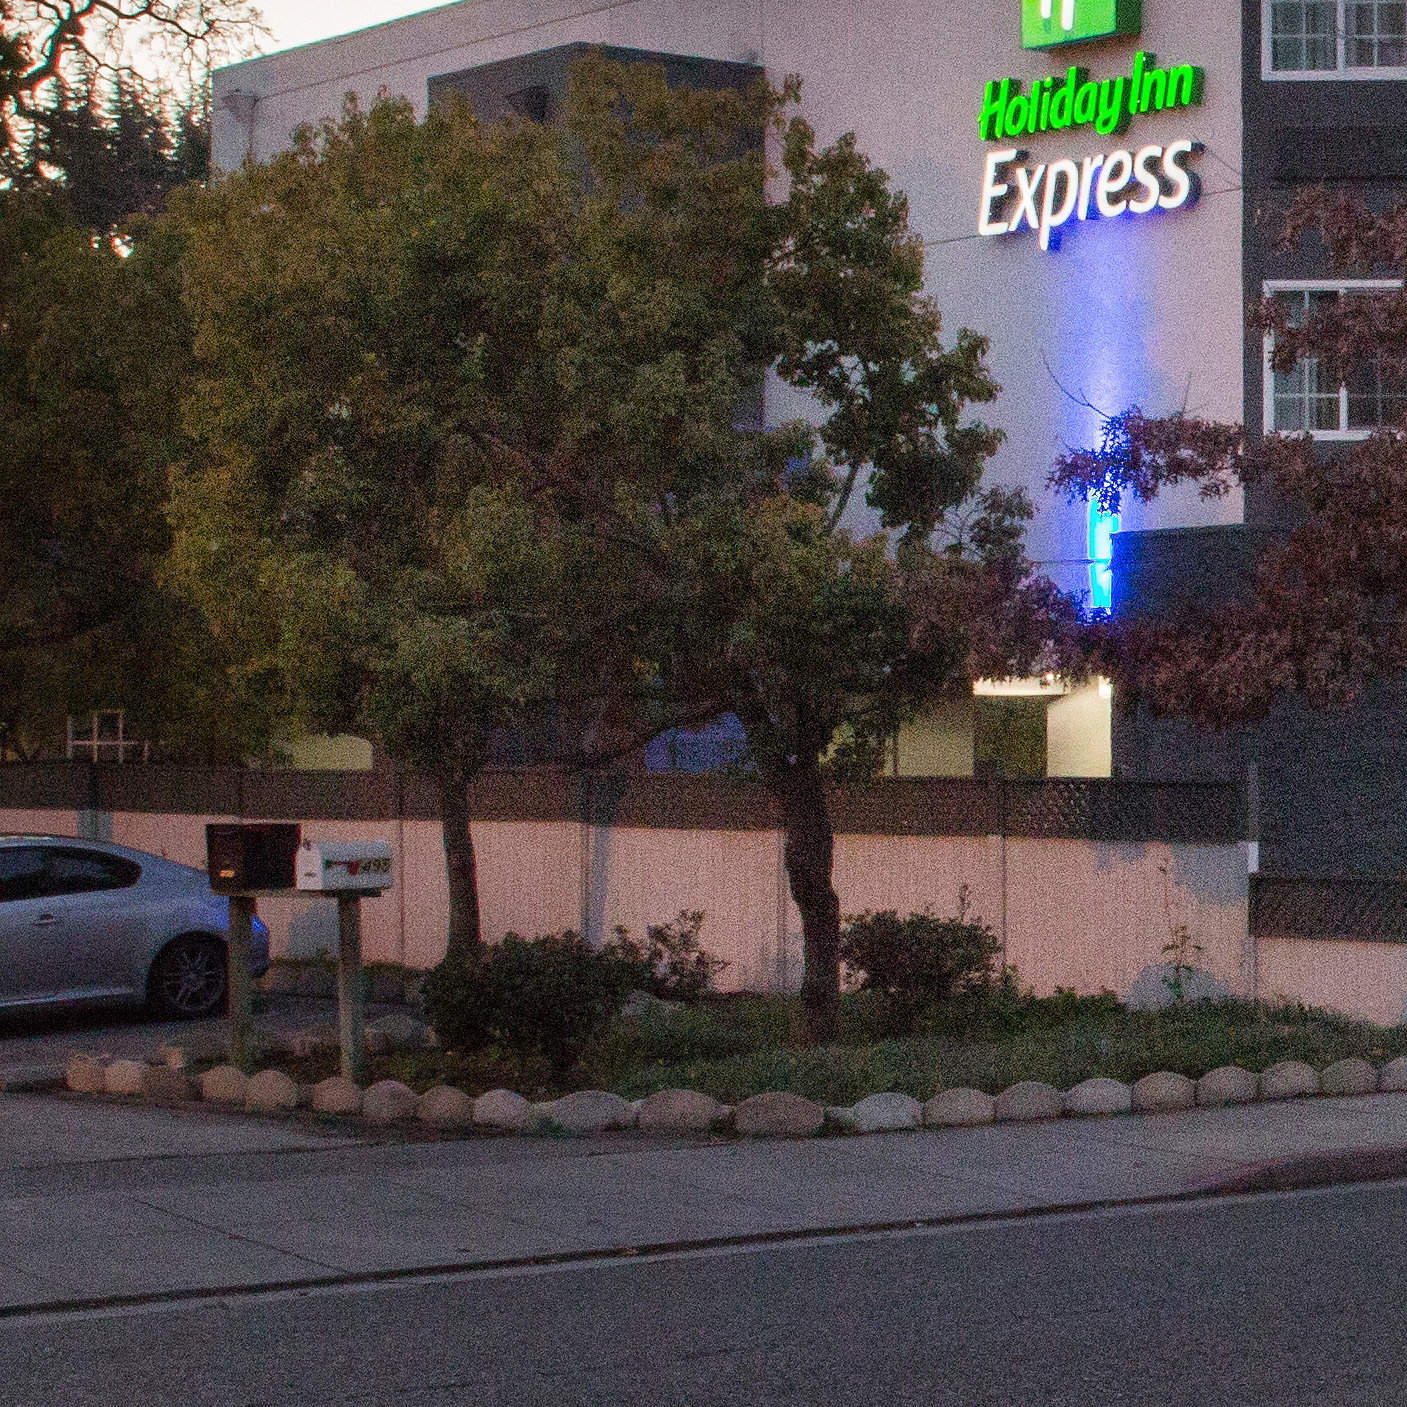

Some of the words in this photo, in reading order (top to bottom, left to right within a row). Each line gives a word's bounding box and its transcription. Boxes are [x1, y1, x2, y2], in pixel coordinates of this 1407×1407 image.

[978, 65, 1123, 140] Holiday
[1128, 51, 1194, 115] Inn
[978, 140, 1193, 251] Express
